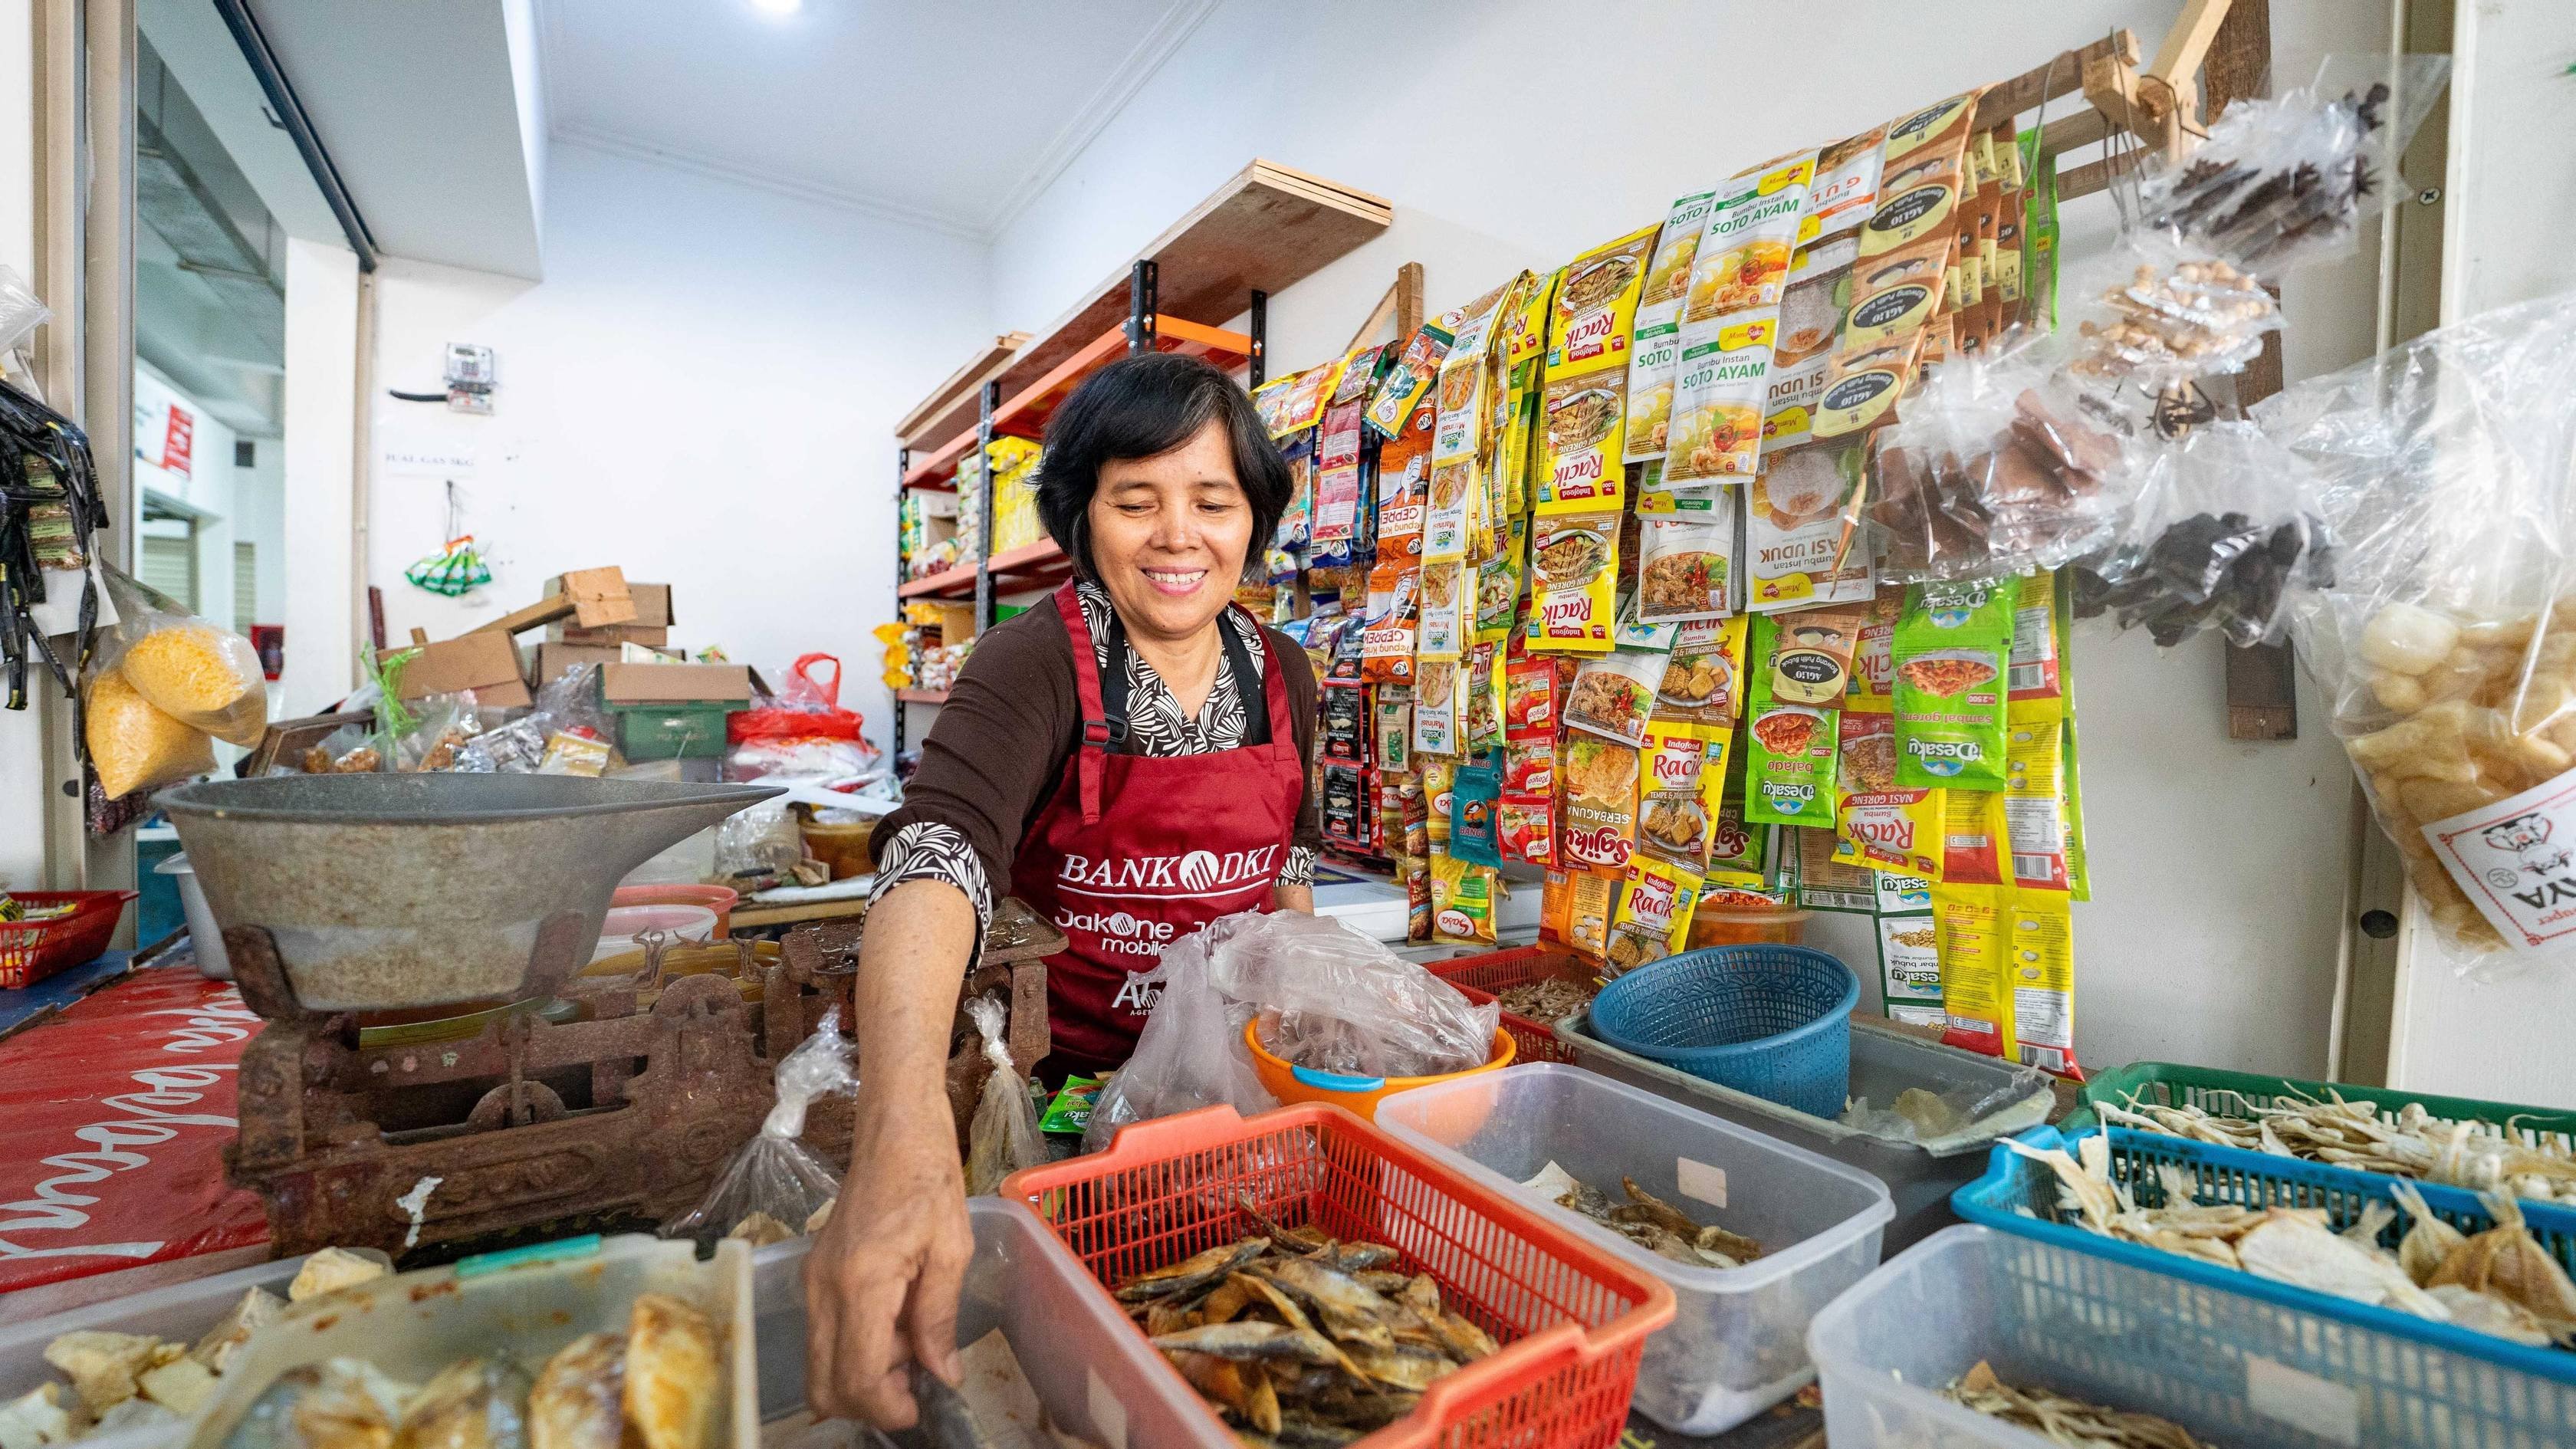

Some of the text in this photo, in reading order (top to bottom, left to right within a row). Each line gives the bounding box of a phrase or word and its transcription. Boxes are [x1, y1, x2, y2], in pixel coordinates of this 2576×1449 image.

[1810, 176, 1861, 202] GUL
[1732, 194, 1785, 218] Bumbu Instan
[1815, 189, 1850, 209] Bumbu
[1668, 207, 1703, 228] SOTO
[1710, 214, 1749, 235] SOTO
[1751, 198, 1799, 225] AYAM
[1891, 205, 1925, 227] AGLIO
[1598, 292, 1620, 305] IKAN
[1872, 304, 1904, 323] AGLIO
[1564, 311, 1616, 348] Racik
[1571, 344, 1600, 358] Indofood
[1638, 350, 1672, 367] SOTO
[1697, 353, 1750, 370] Bumbu Instan
[1683, 362, 1766, 389] SOTO AYAM
[1769, 371, 1824, 398] SI UDU
[1773, 386, 1822, 407] mbu Instan
[1840, 390, 1873, 407] AGLIO
[1558, 432, 1606, 453] IKAN GORENG
[1552, 454, 1603, 488] Racik
[1562, 488, 1590, 498] Indofood
[1395, 522, 1424, 534] Tepung
[1760, 538, 1838, 563] ASI UDUK
[1774, 555, 1835, 570] umbu Instan
[1546, 575, 1593, 592] IKAN GORENG
[1920, 590, 1987, 613] Desaku
[1541, 598, 1592, 626] Racik
[1551, 627, 1580, 636] Indofood
[1682, 618, 1725, 632] acik
[1865, 626, 1893, 639] RENG
[1379, 642, 1411, 654] Tepung
[1698, 644, 1722, 653] GORENG
[1781, 656, 1838, 674] Bawang Putih Bubuk
[1859, 653, 1892, 681] cik
[1796, 671, 1822, 682] AGLIO
[1529, 708, 1548, 718] Royco
[1900, 711, 1993, 725] sambal goreng
[1667, 739, 1700, 751] Indofood
[1907, 738, 1983, 762] Desaku
[1469, 757, 1493, 768] ANGO
[1652, 753, 1703, 779] Racik
[1766, 760, 1814, 774] balado
[1528, 775, 1549, 785] Royco
[1763, 780, 1815, 801] Desaku
[1852, 794, 1914, 805] NASI GORENG
[1567, 805, 1632, 824] SERBAGUNA
[1459, 827, 1488, 839] BANGO
[1529, 843, 1548, 853] Royco
[1564, 826, 1634, 863] Sajiku
[1057, 843, 1280, 888] BANK DKI
[1646, 876, 1674, 892] Indofood
[1884, 876, 1928, 892] esaku
[1628, 888, 1676, 919] Racik
[1442, 916, 1470, 935] Sasa
[1619, 922, 1635, 932] TEMPE
[1891, 959, 1917, 968] bubuk
[1891, 967, 1939, 985] esaku
[1063, 1111, 1090, 1121] aku
